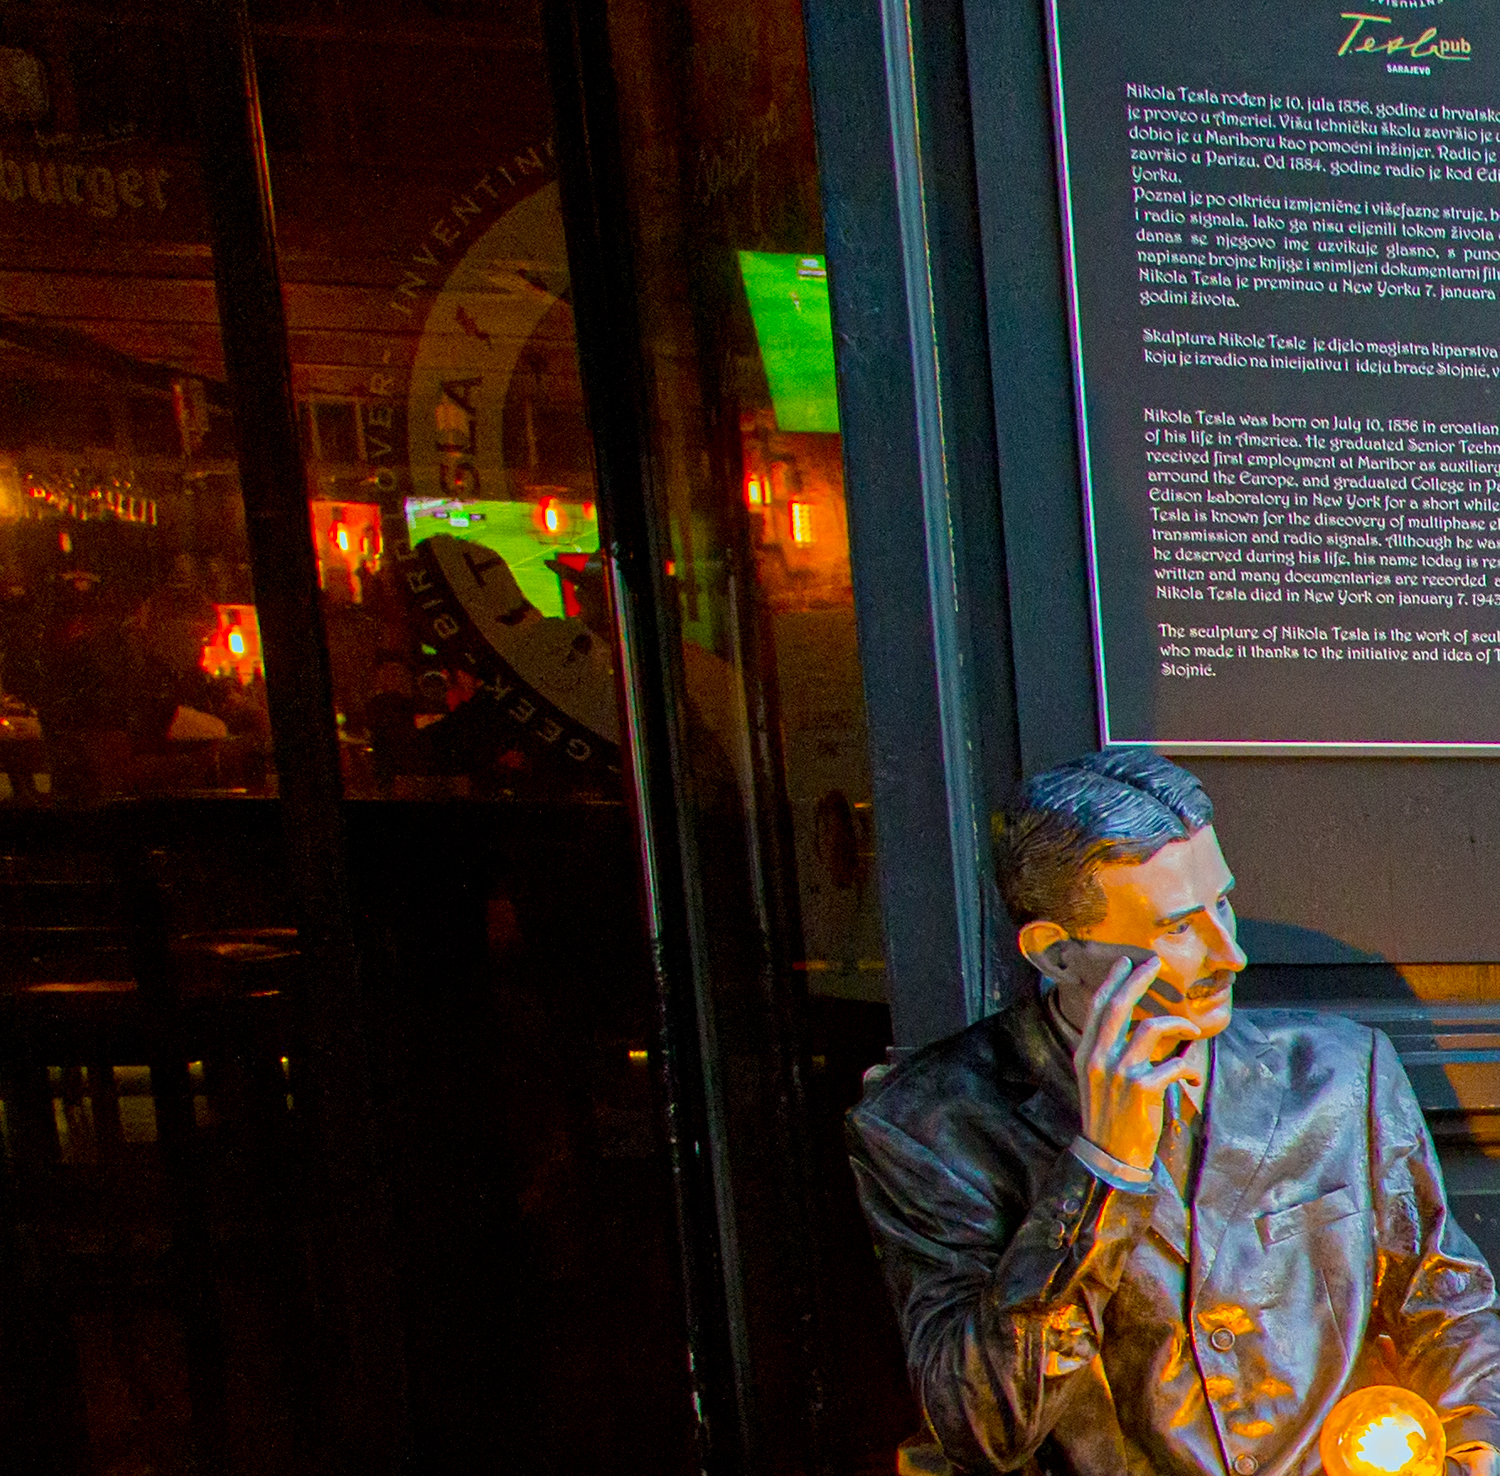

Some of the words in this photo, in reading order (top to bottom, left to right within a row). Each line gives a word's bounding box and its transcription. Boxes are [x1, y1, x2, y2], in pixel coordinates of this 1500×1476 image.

[1440, 38, 1472, 55] pub
[1386, 63, 1431, 76] SARAJEVO
[1127, 83, 1176, 101] Nikola
[1177, 86, 1219, 104] Tesla
[1221, 91, 1266, 107] rođen
[1269, 94, 1282, 111] je
[1307, 97, 1335, 113] jula
[1376, 102, 1426, 118] godine
[1429, 108, 1439, 119] u
[1137, 249, 1206, 266] napisane
[1208, 252, 1257, 270] brojne
[1259, 254, 1303, 273] knjige
[1306, 258, 1310, 271] i
[1313, 259, 1378, 276] snimljeni
[1380, 262, 1480, 280] dokumentarni
[1144, 408, 1192, 424] Nikola
[1195, 410, 1236, 426] Tesla
[1239, 415, 1268, 427] was
[1272, 414, 1307, 428] born
[1310, 418, 1330, 429] on
[1333, 416, 1361, 434] July
[1388, 419, 1419, 433] 1856
[1422, 420, 1436, 433] in
[1440, 422, 1499, 436] croatian
[1144, 428, 1160, 445] of
[1164, 429, 1187, 443] his
[1191, 430, 1214, 447] life
[1218, 432, 1232, 445] in
[1305, 434, 1326, 450] He
[1329, 436, 1404, 452] graduated
[1408, 438, 1456, 453] Senior
[1146, 450, 1209, 465] received
[1214, 450, 1243, 467] first
[1247, 453, 1336, 471] employment
[1340, 457, 1353, 469] at
[1358, 456, 1416, 471] Maribor
[1419, 461, 1436, 472] as
[1148, 470, 1209, 484] arround
[1213, 470, 1236, 485] the
[1302, 474, 1330, 488] and
[1333, 475, 1407, 491] graduated
[1411, 475, 1465, 494] College
[1469, 479, 1482, 492] in
[1149, 487, 1202, 503] Edison
[1207, 489, 1290, 509] Laboratory
[1294, 493, 1308, 506] in
[1313, 493, 1343, 508] New
[1346, 494, 1381, 510] York
[1385, 495, 1406, 512] for
[1409, 499, 1419, 510] a
[1422, 497, 1459, 511] short
[1158, 623, 1185, 639] The
[1189, 625, 1259, 641] sculpture
[1262, 626, 1278, 642] of
[1282, 626, 1328, 640] Nikola
[1331, 626, 1370, 642] Tesla
[1374, 628, 1387, 641] is
[1390, 628, 1412, 643] the
[1415, 629, 1451, 642] work
[1453, 629, 1469, 645] of
[1160, 643, 1191, 657] who
[1194, 644, 1234, 659] made
[1238, 645, 1247, 658] it
[1251, 645, 1300, 659] thanks
[1303, 647, 1318, 659] to
[1321, 646, 1344, 661] the
[1347, 647, 1409, 661] initiative
[1412, 648, 1439, 661] and
[1443, 648, 1473, 662] idea
[1476, 648, 1491, 665] of
